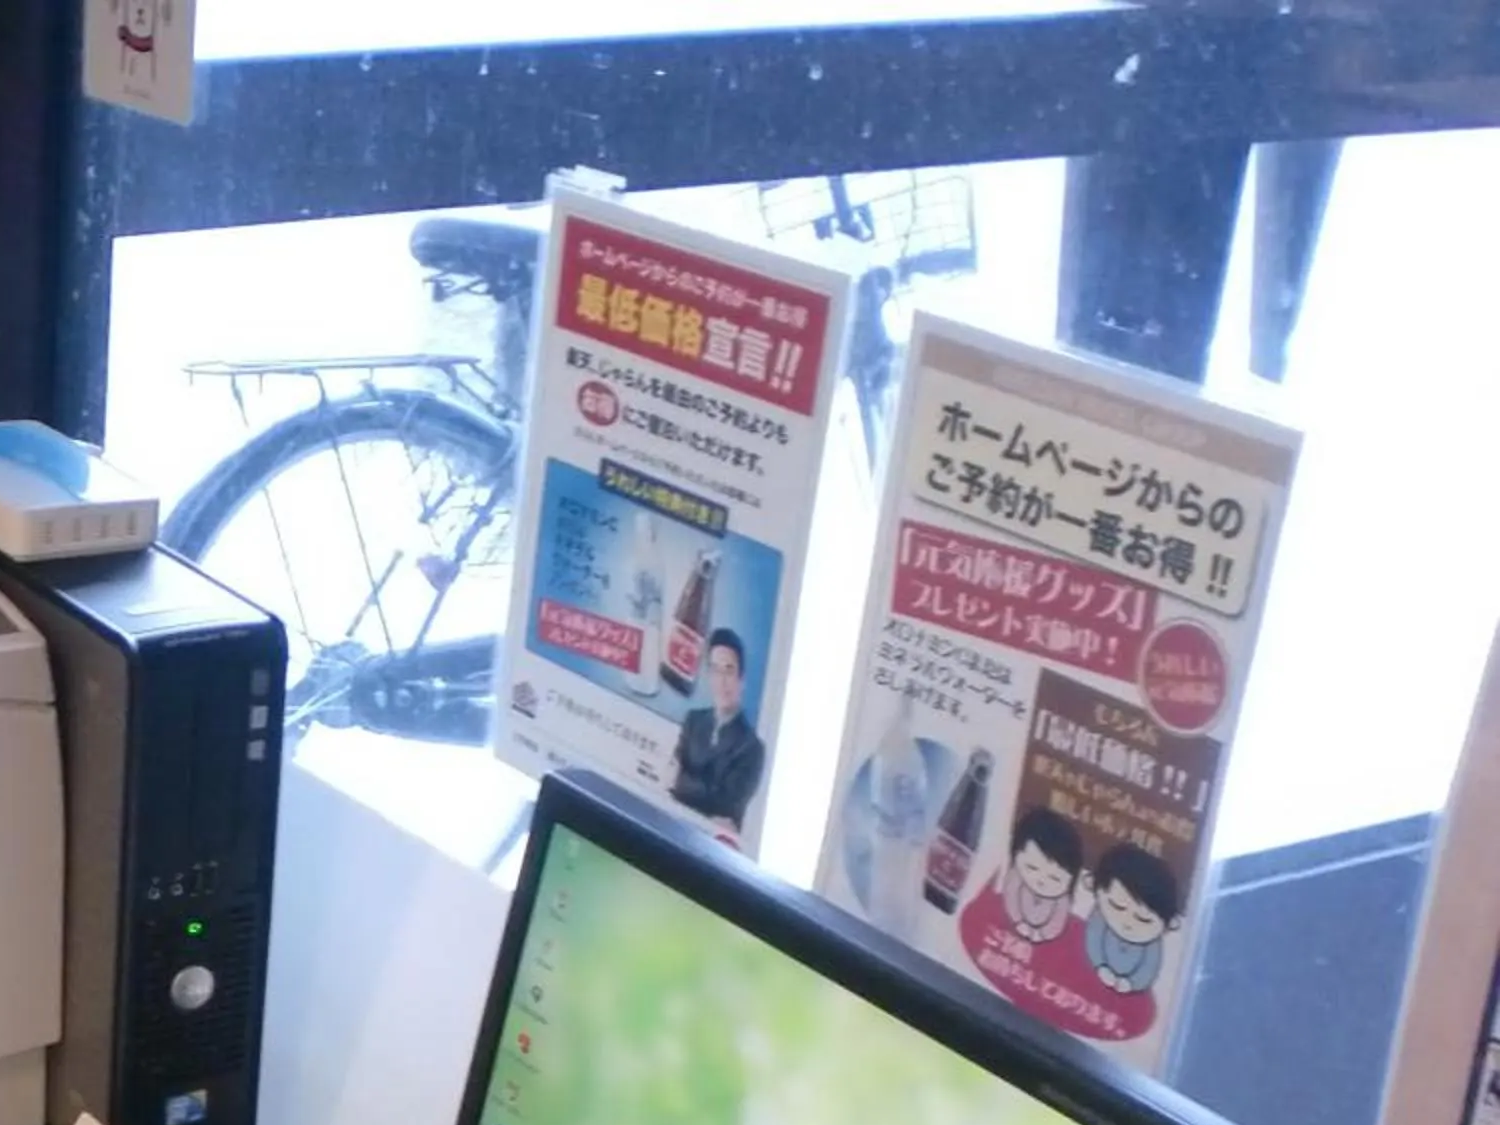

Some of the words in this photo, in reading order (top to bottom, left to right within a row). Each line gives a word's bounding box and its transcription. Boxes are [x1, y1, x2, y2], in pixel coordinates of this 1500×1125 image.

[937, 401, 1245, 540] ホームページからの
